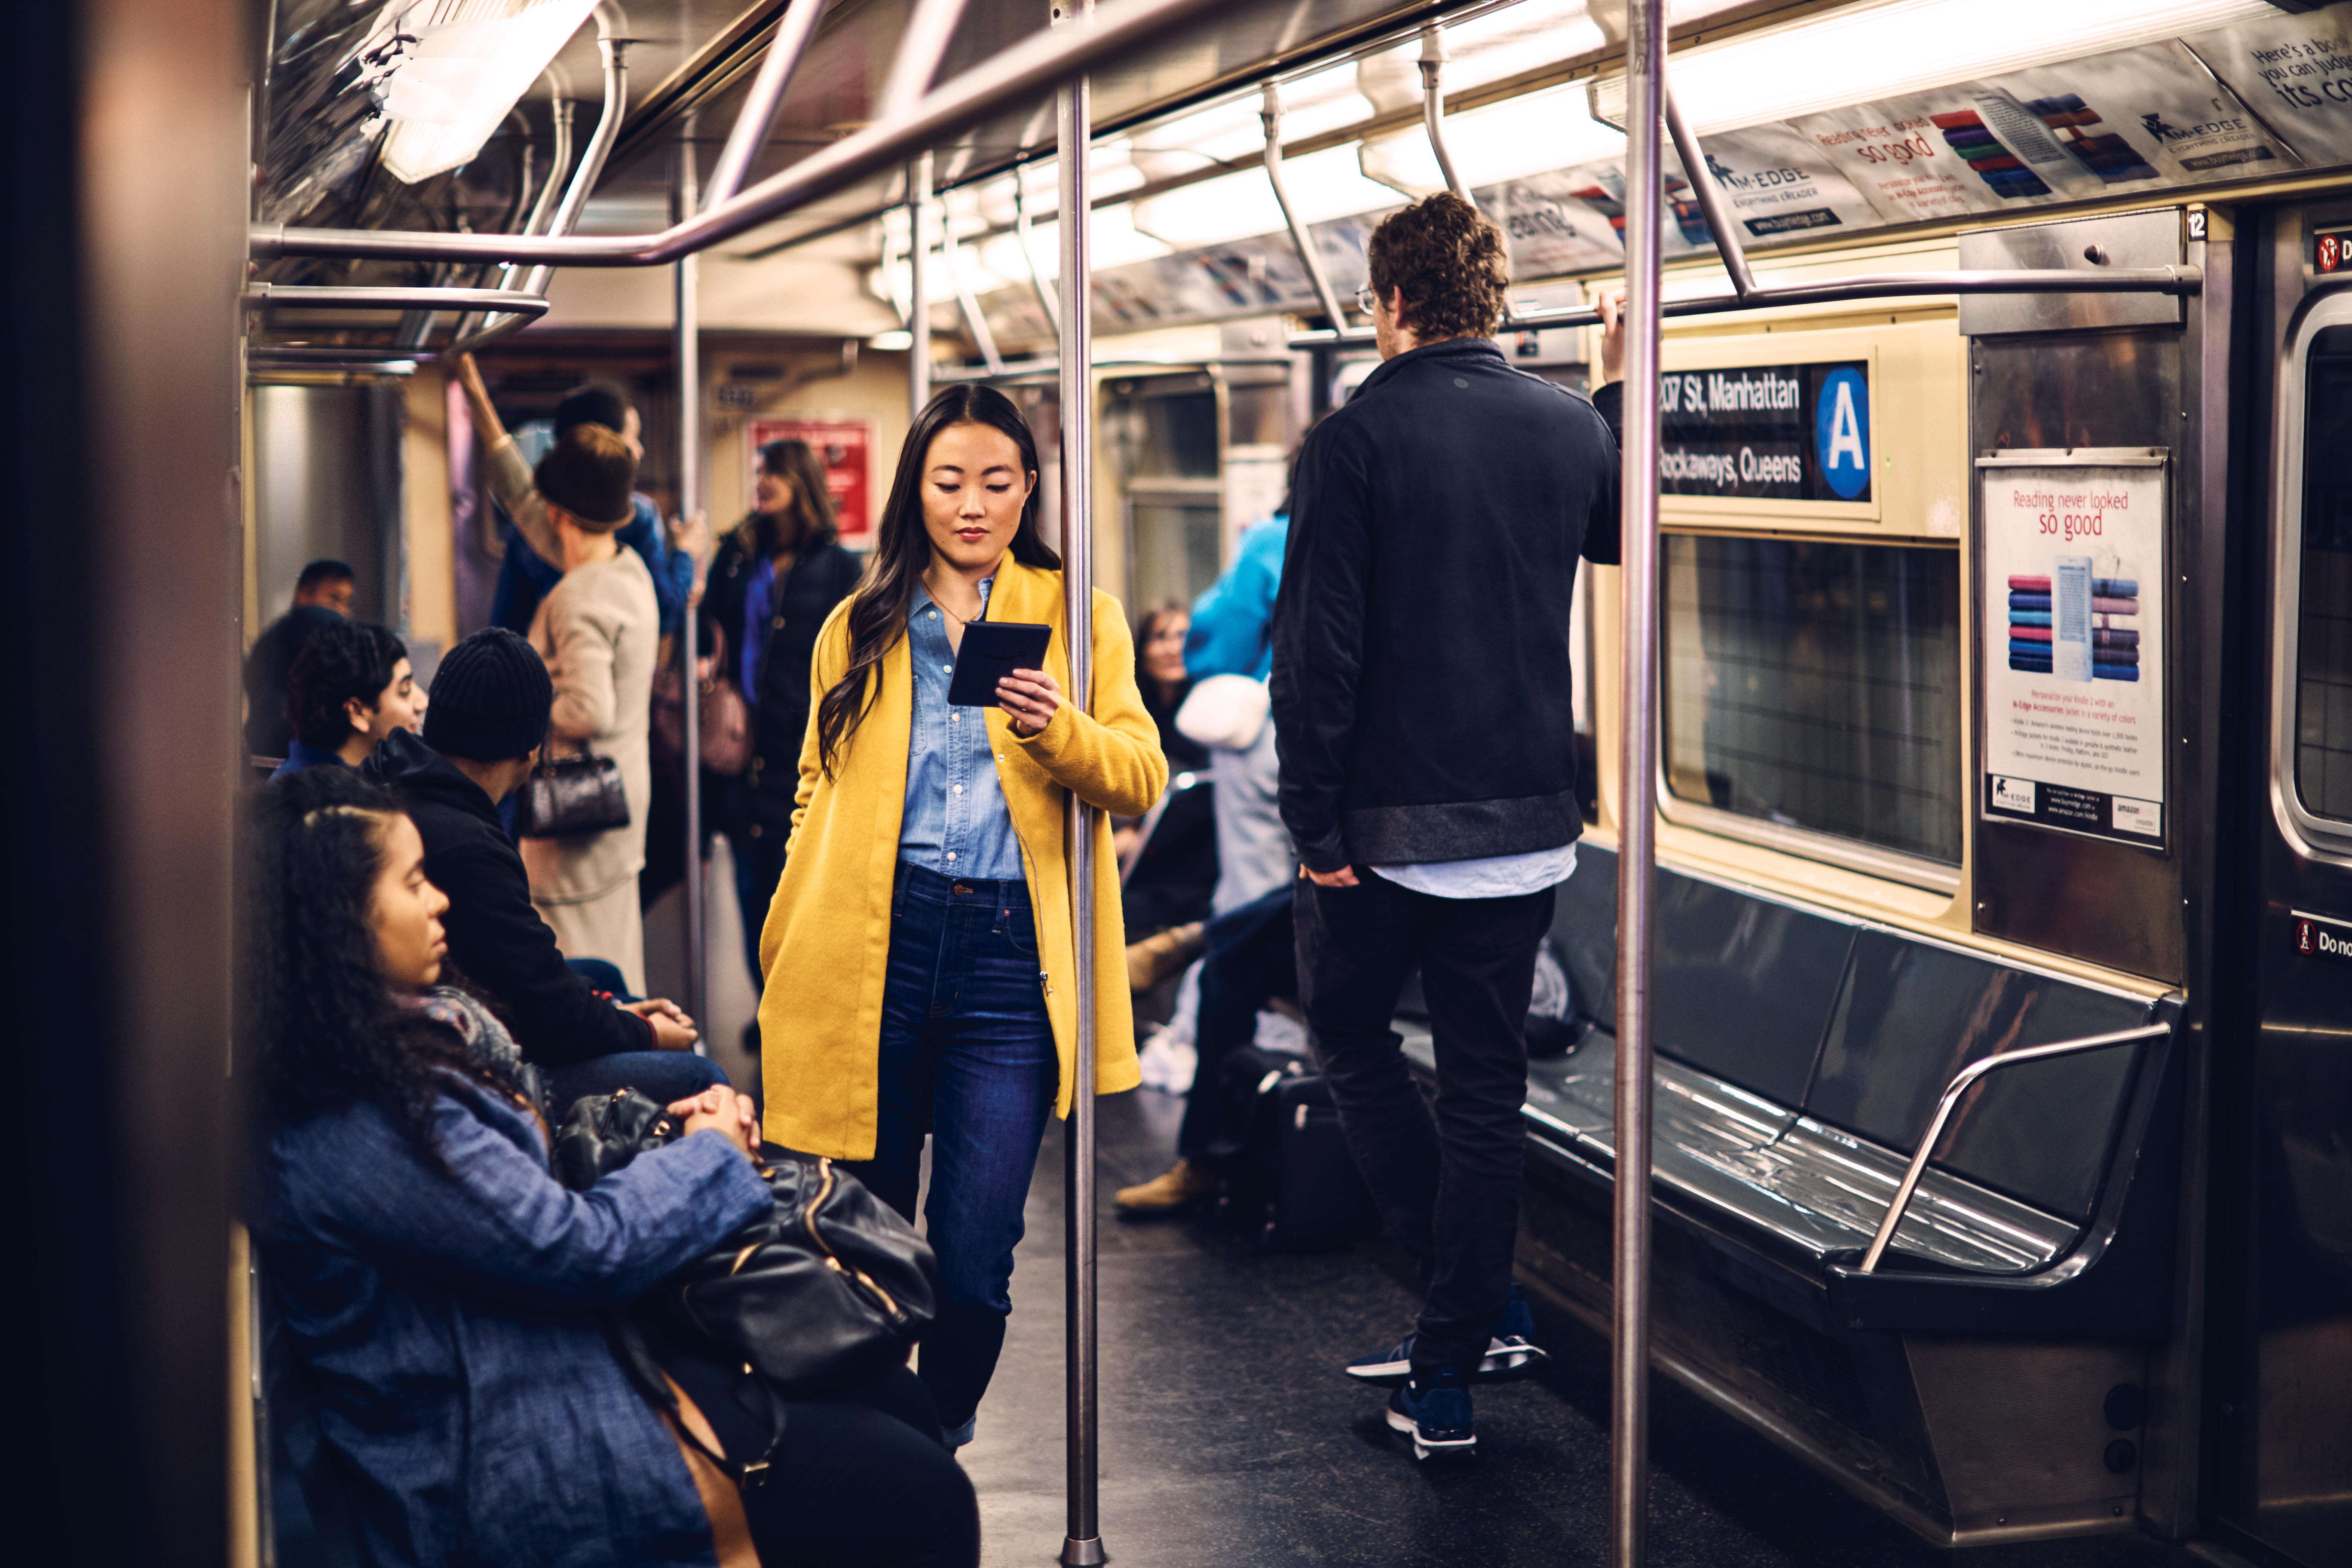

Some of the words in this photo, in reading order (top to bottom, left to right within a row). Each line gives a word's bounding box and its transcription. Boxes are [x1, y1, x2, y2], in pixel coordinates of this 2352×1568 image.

[2251, 43, 2303, 64] Here's
[2303, 44, 2316, 55] a
[2258, 67, 2288, 88] you
[2289, 63, 2317, 76] can
[2276, 83, 2323, 108] its
[1893, 116, 1931, 132] ooked
[2172, 119, 2248, 140] M-EDGE
[1857, 145, 1887, 164] so
[1883, 131, 1935, 165] good
[1735, 167, 1810, 190] M-EDGE
[2189, 213, 2205, 237] 12
[1684, 374, 1707, 419] St,
[1708, 372, 1800, 411] Manhattan
[1828, 382, 1865, 469] A
[1740, 446, 1801, 483] Queens
[2014, 490, 2054, 512] Reading
[2058, 495, 2087, 508] never
[2091, 491, 2128, 509] looked
[2040, 514, 2058, 534] so
[2064, 508, 2102, 541] good
[2119, 715, 2136, 724] colors
[2320, 931, 2337, 952] Do
